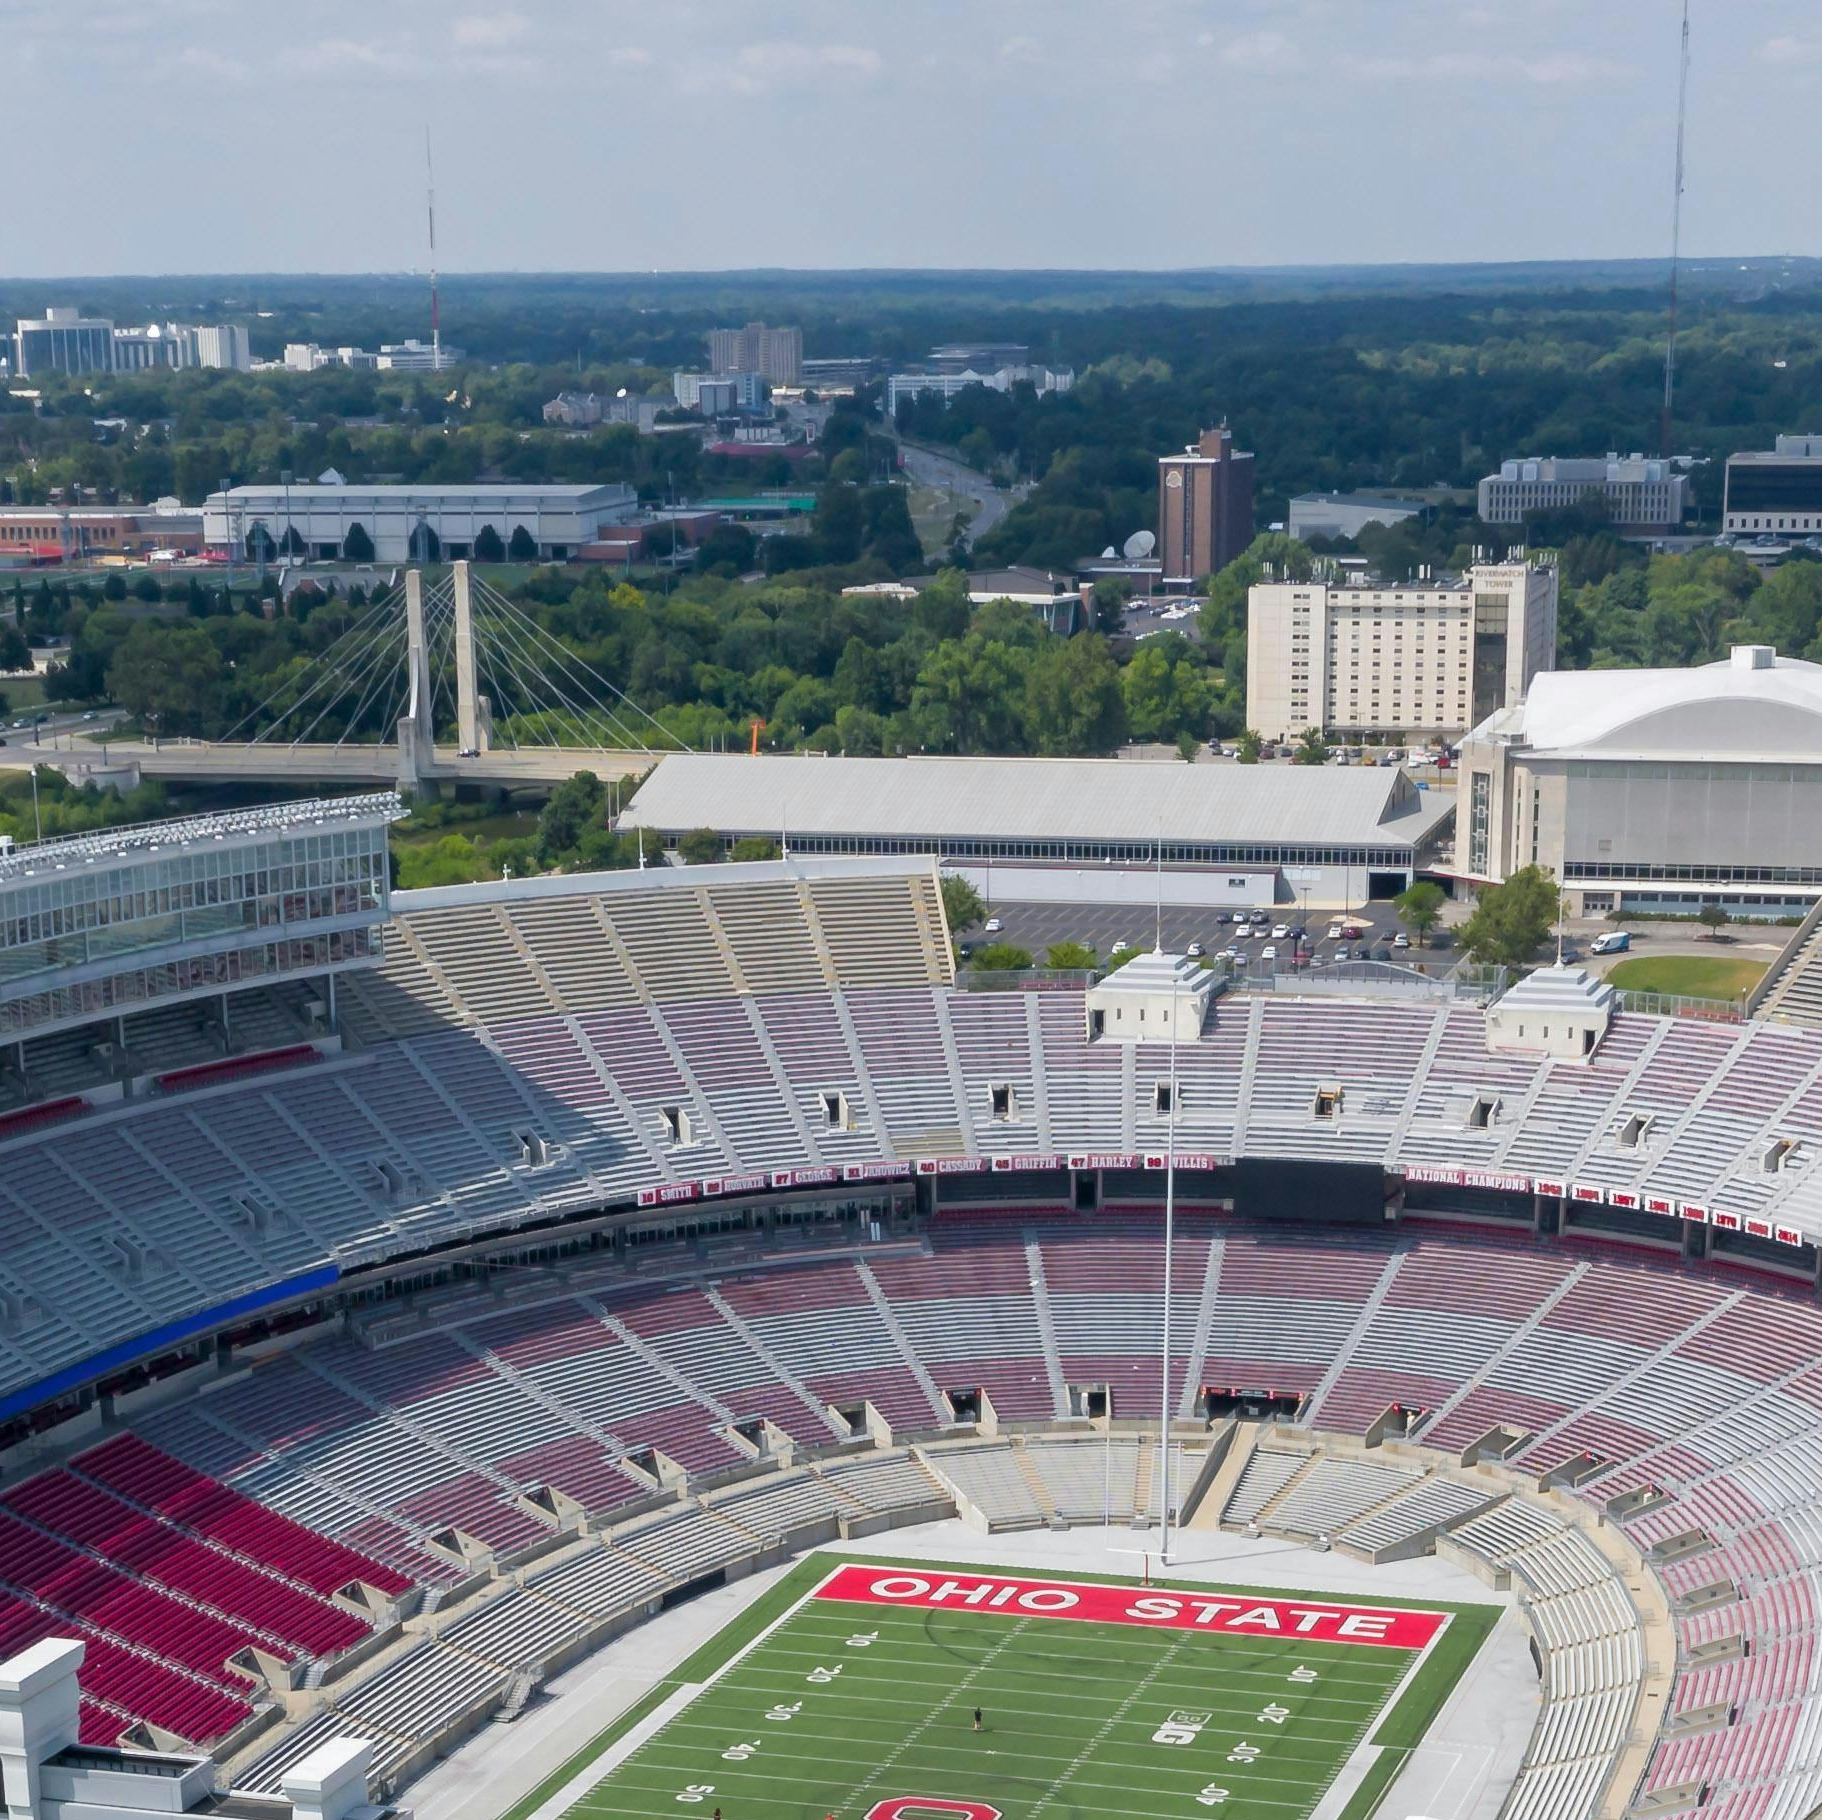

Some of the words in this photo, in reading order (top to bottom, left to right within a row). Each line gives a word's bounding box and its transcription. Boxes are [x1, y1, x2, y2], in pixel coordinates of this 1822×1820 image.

[1485, 580, 1513, 588] TOWER
[920, 1162, 935, 1173] 40
[938, 1159, 983, 1172] CASSADY
[1015, 1157, 1057, 1170] GRIFFIN
[1070, 1157, 1085, 1168] 47
[1091, 1156, 1134, 1168] HARLEY
[795, 1169, 833, 1183] GEORGE
[1408, 1167, 1460, 1184] NATIONAL
[1465, 1173, 1527, 1191] CHAMPIONS
[660, 1186, 692, 1201] SMITH
[869, 1576, 1080, 1611] OHIO
[1124, 1598, 1395, 1639] STATE
[845, 1633, 877, 1647] 10
[806, 1666, 841, 1682] 20
[1286, 1669, 1318, 1683] 10
[764, 1704, 800, 1721] 30
[1256, 1706, 1290, 1724] 20
[721, 1743, 756, 1760] 40
[1226, 1746, 1261, 1763] 30
[675, 1784, 716, 1802] 50
[1195, 1788, 1230, 1805] 40
